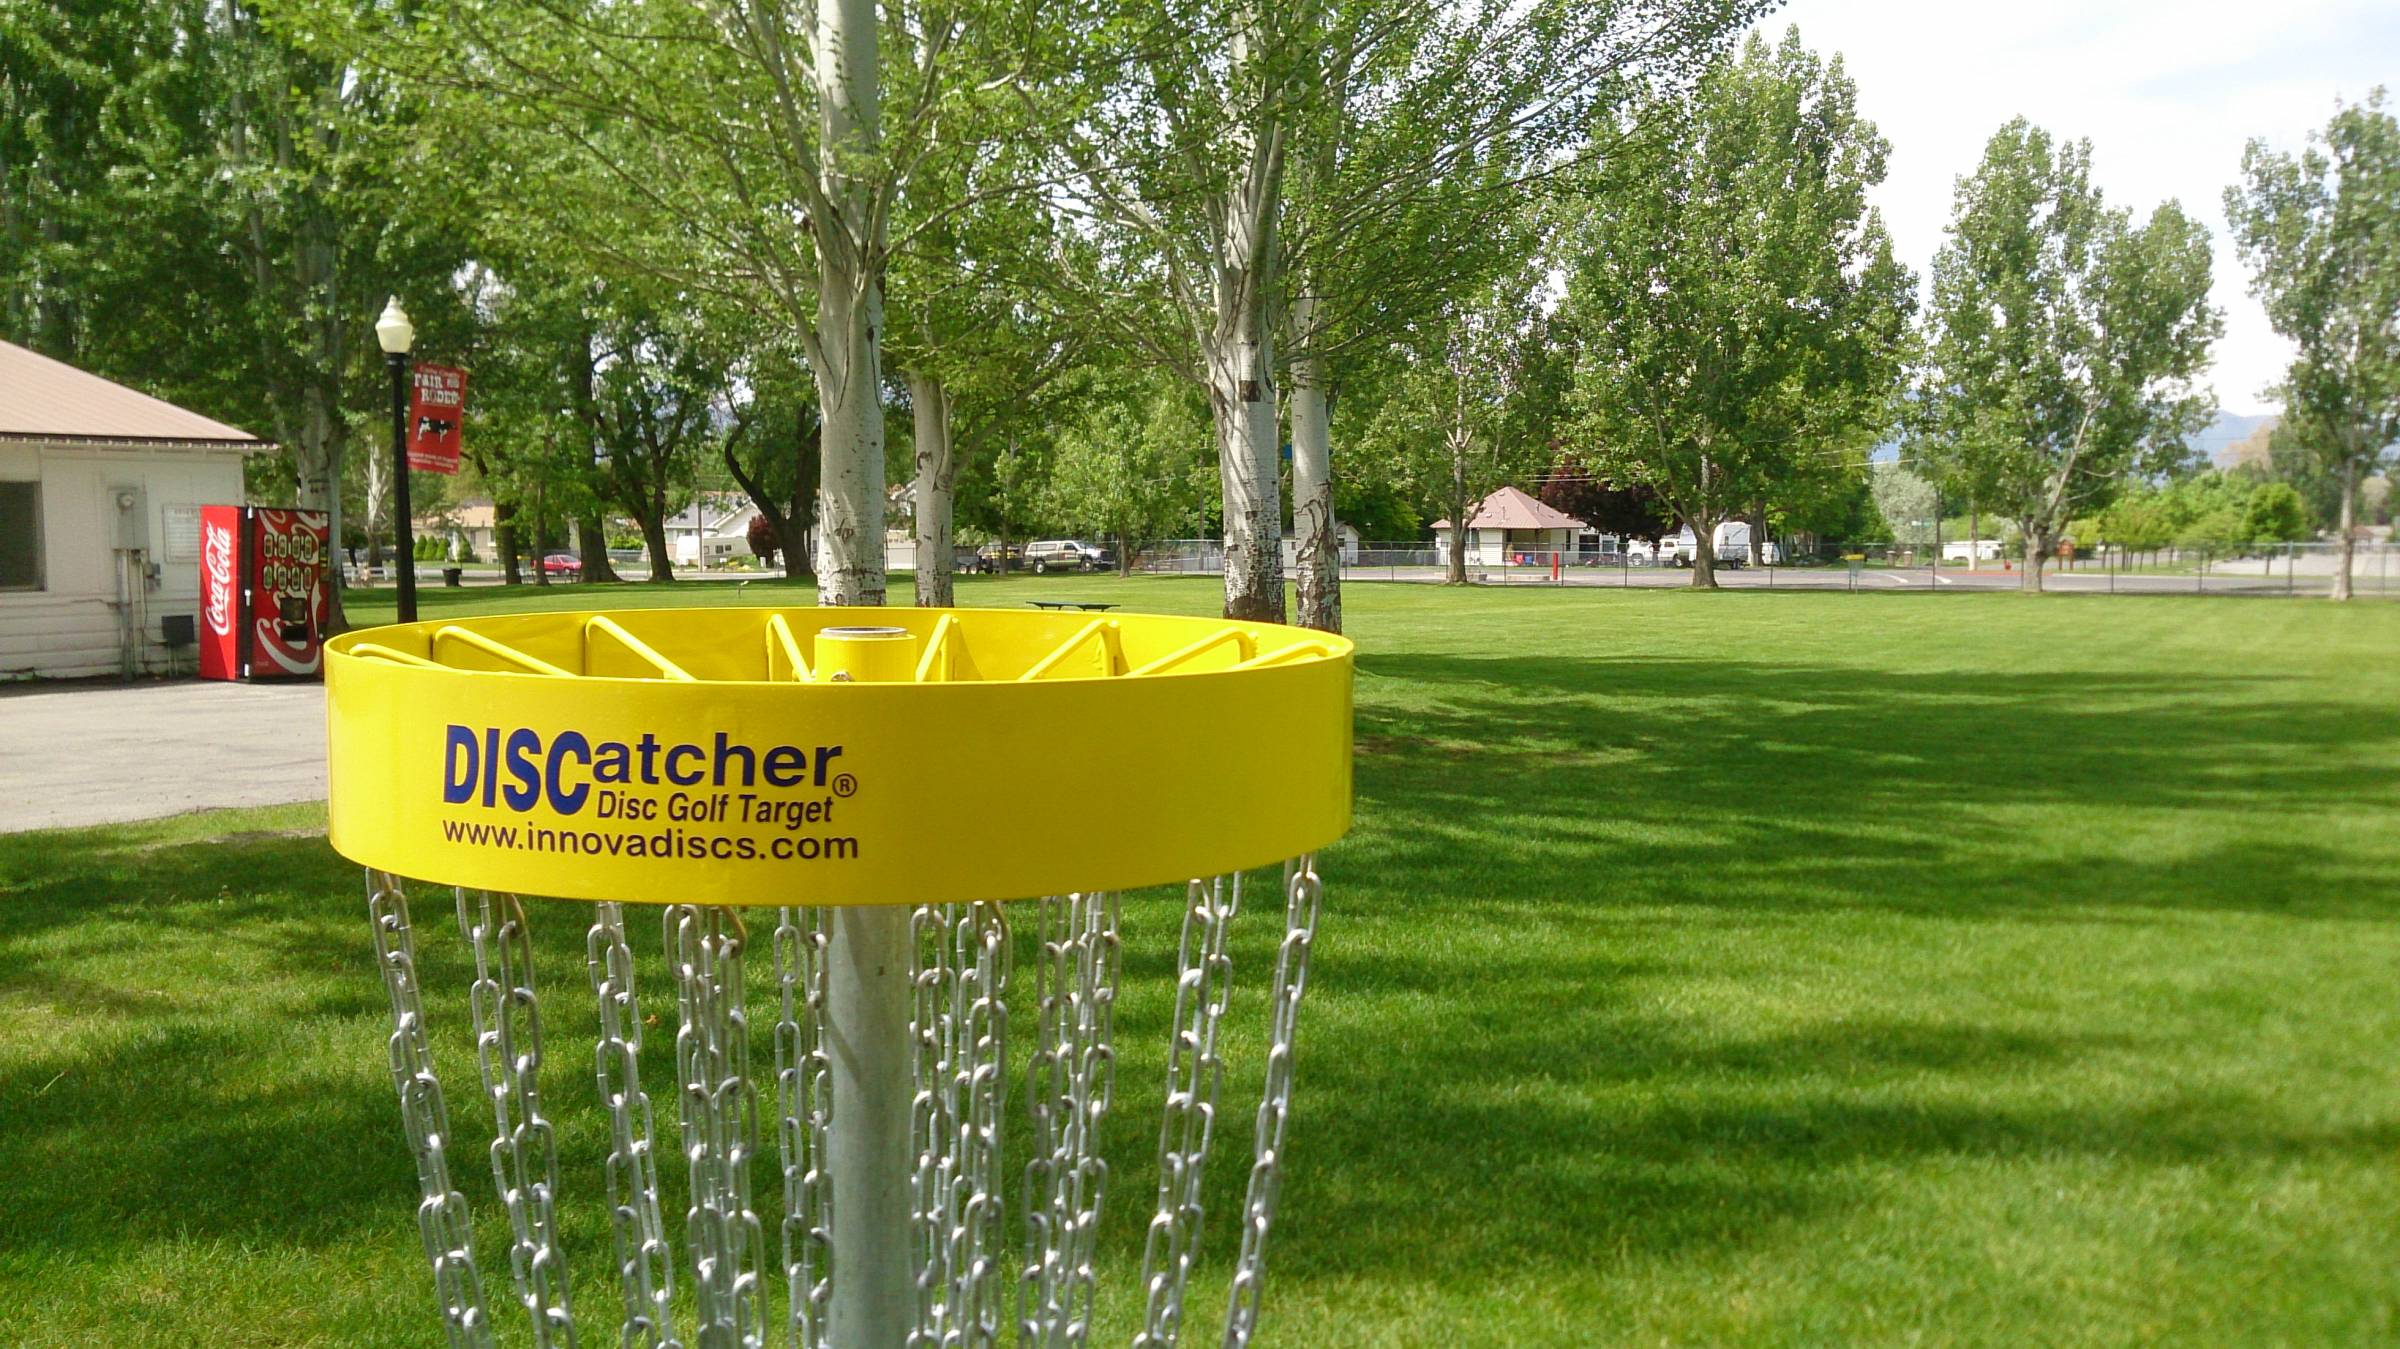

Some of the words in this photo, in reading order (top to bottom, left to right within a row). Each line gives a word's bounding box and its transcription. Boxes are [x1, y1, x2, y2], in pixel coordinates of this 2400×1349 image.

[414, 373, 443, 388] FAIR
[597, 791, 657, 821] Disc
[668, 792, 729, 822] Golf
[738, 794, 833, 831] Target
[443, 820, 858, 859] www.innovadiscs.com
